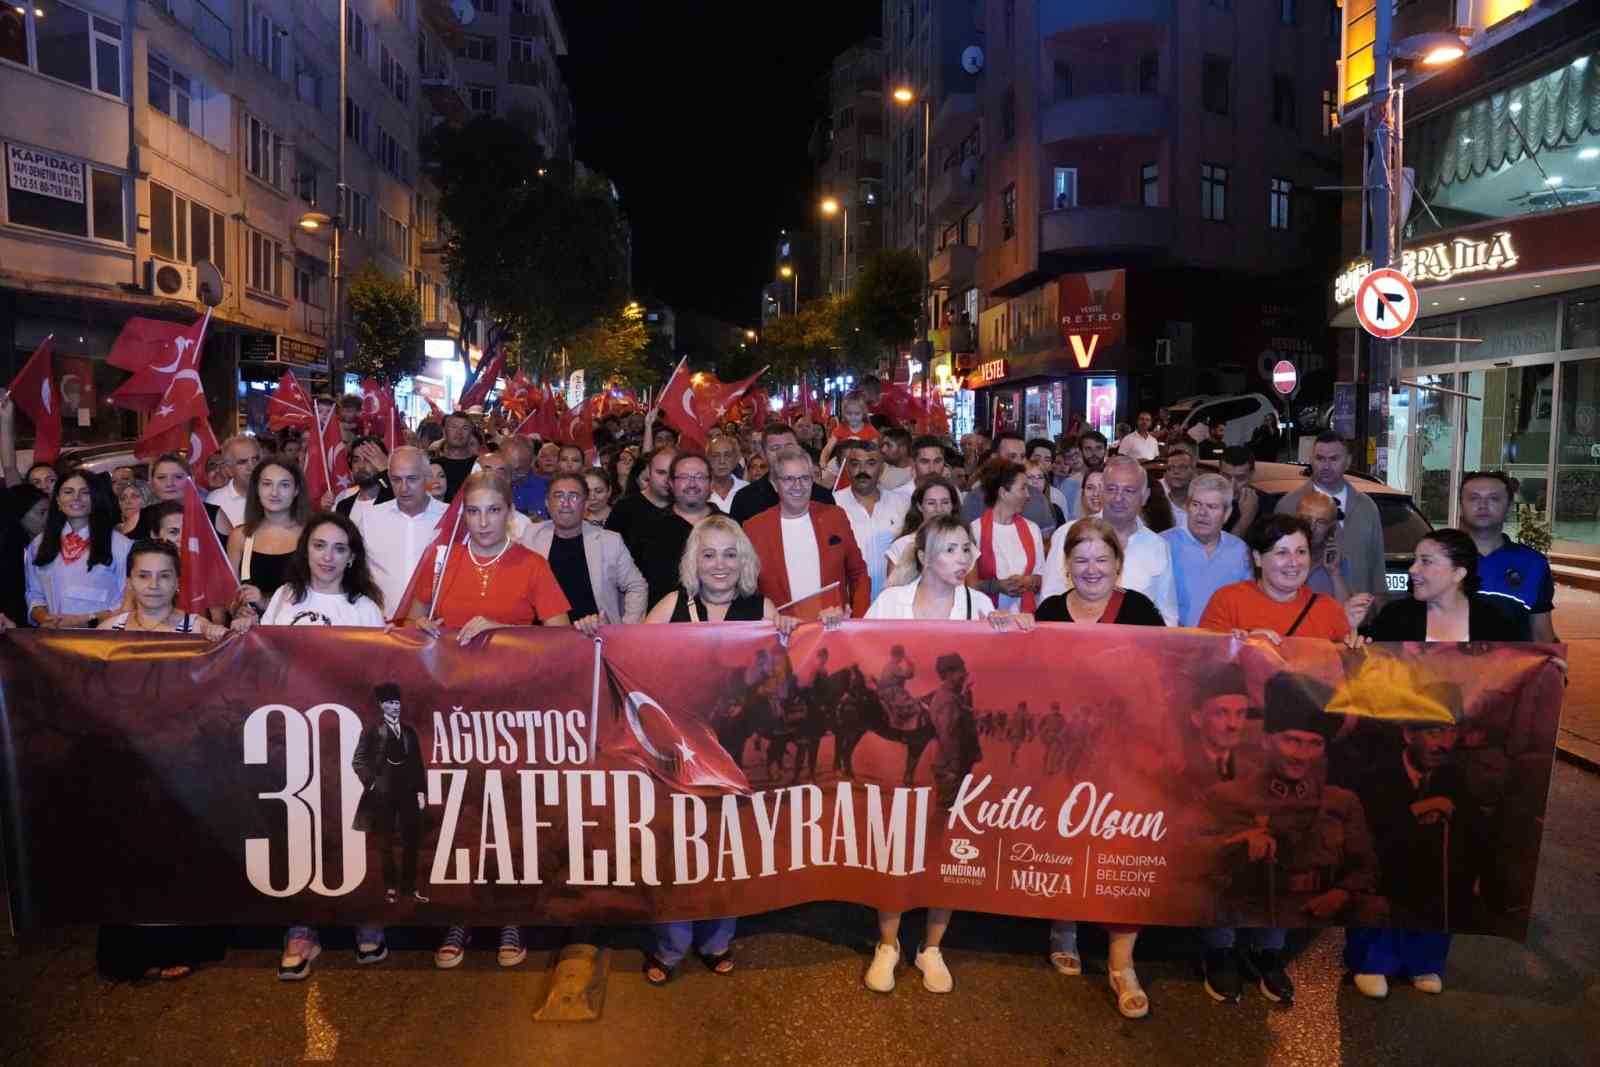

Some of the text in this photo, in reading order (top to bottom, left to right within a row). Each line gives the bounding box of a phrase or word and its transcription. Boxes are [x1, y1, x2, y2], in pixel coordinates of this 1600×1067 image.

[1062, 312, 1121, 325] RETRO
[1069, 334, 1100, 368] V
[978, 359, 1005, 381] VESTEL
[431, 706, 588, 765] AĞUSTOS
[243, 703, 367, 897] 30
[948, 773, 1167, 842] Kutlu Olsun
[427, 769, 933, 887] ZAFER BAYRAMI
[1010, 842, 1073, 865] Dursun
[1097, 853, 1168, 867] BANDIRMA
[1010, 865, 1072, 898] MİRZA
[1096, 868, 1157, 883] BELEDİYE
[1095, 884, 1151, 899] BAŞKANI
